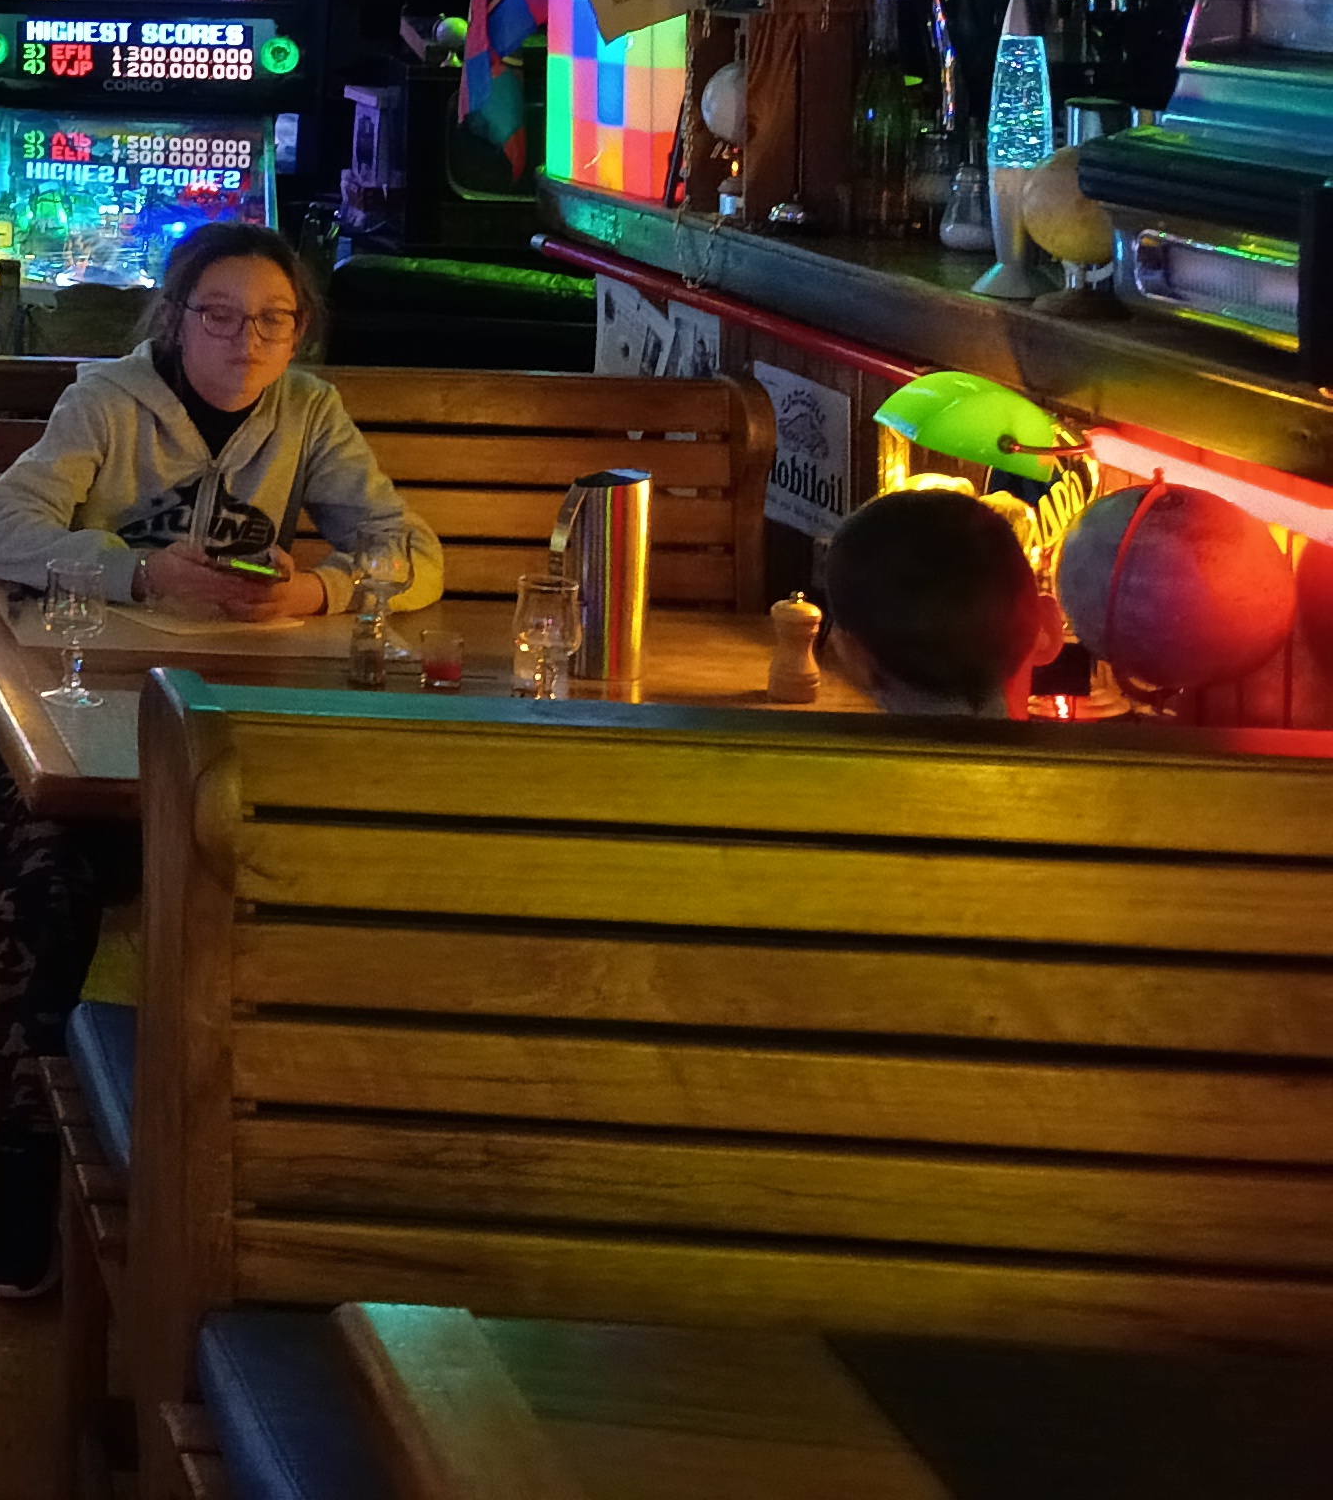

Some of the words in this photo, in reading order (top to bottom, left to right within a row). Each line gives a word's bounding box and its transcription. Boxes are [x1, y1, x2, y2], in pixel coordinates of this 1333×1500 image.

[25, 20, 133, 44] HIGHEST
[141, 23, 244, 46] SCORES
[51, 44, 93, 61] EFH
[51, 60, 94, 78] VJP
